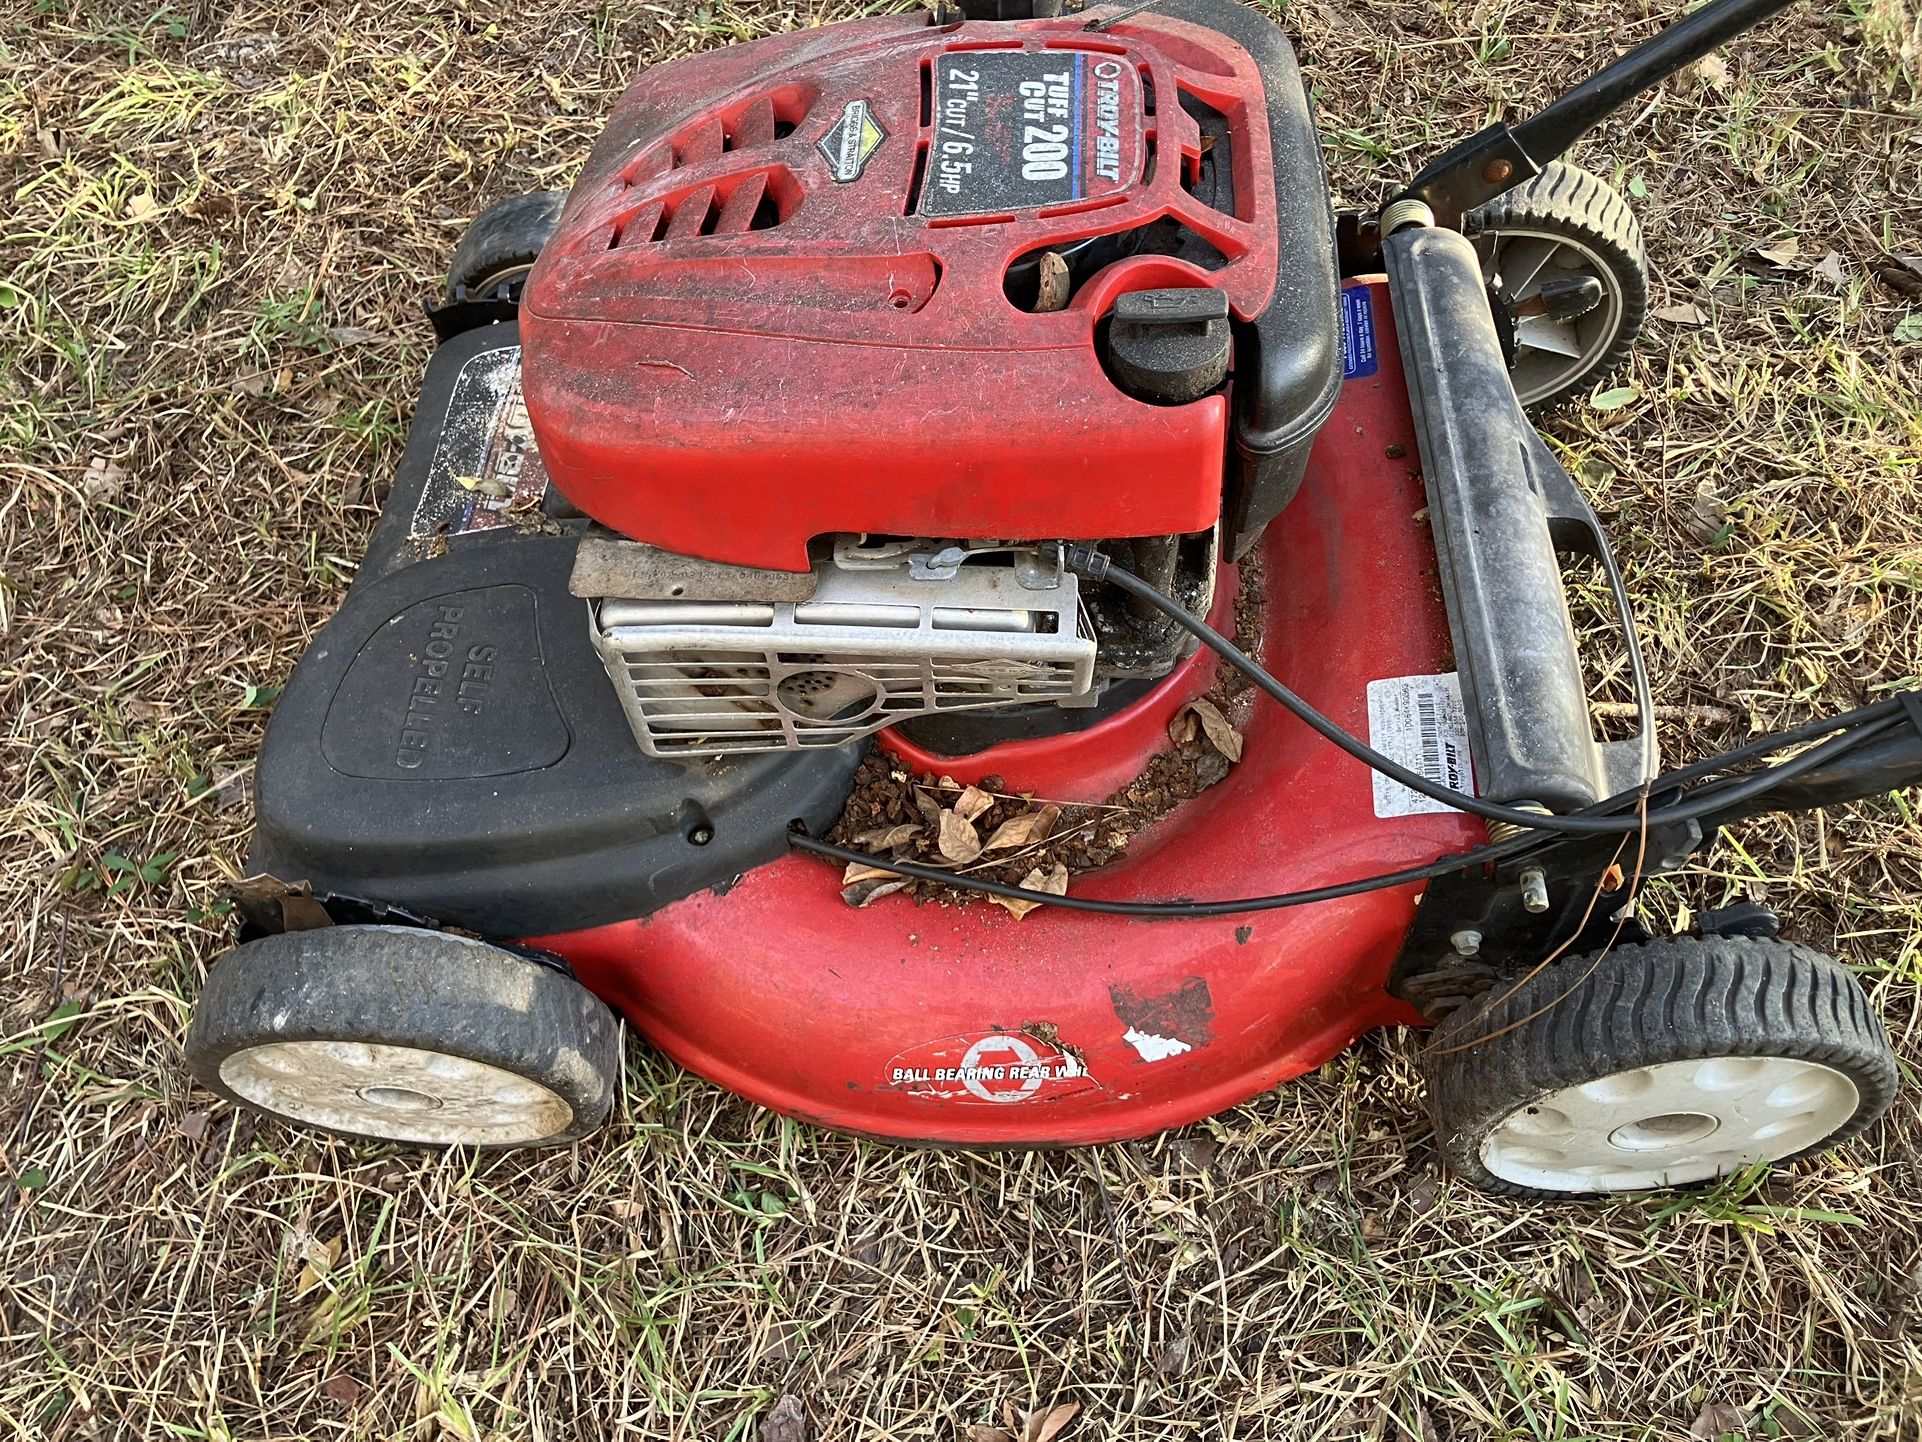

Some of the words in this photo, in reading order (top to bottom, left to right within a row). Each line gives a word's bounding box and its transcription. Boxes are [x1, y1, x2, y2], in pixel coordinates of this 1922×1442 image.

[849, 105, 861, 132] BRIGGS
[1018, 81, 1046, 123] CUT
[1043, 71, 1070, 119] TUFF
[1021, 124, 1069, 182] 200
[1094, 79, 1120, 184] TROY-BILT
[844, 138, 858, 177] STRATTON
[396, 605, 465, 770] PROPELLED
[455, 643, 499, 715] SELF
[1445, 742, 1459, 791] ROY-BILT
[892, 1067, 931, 1082] BALL
[934, 1066, 1006, 1081] BEARING
[1008, 1065, 1051, 1080] REAR
